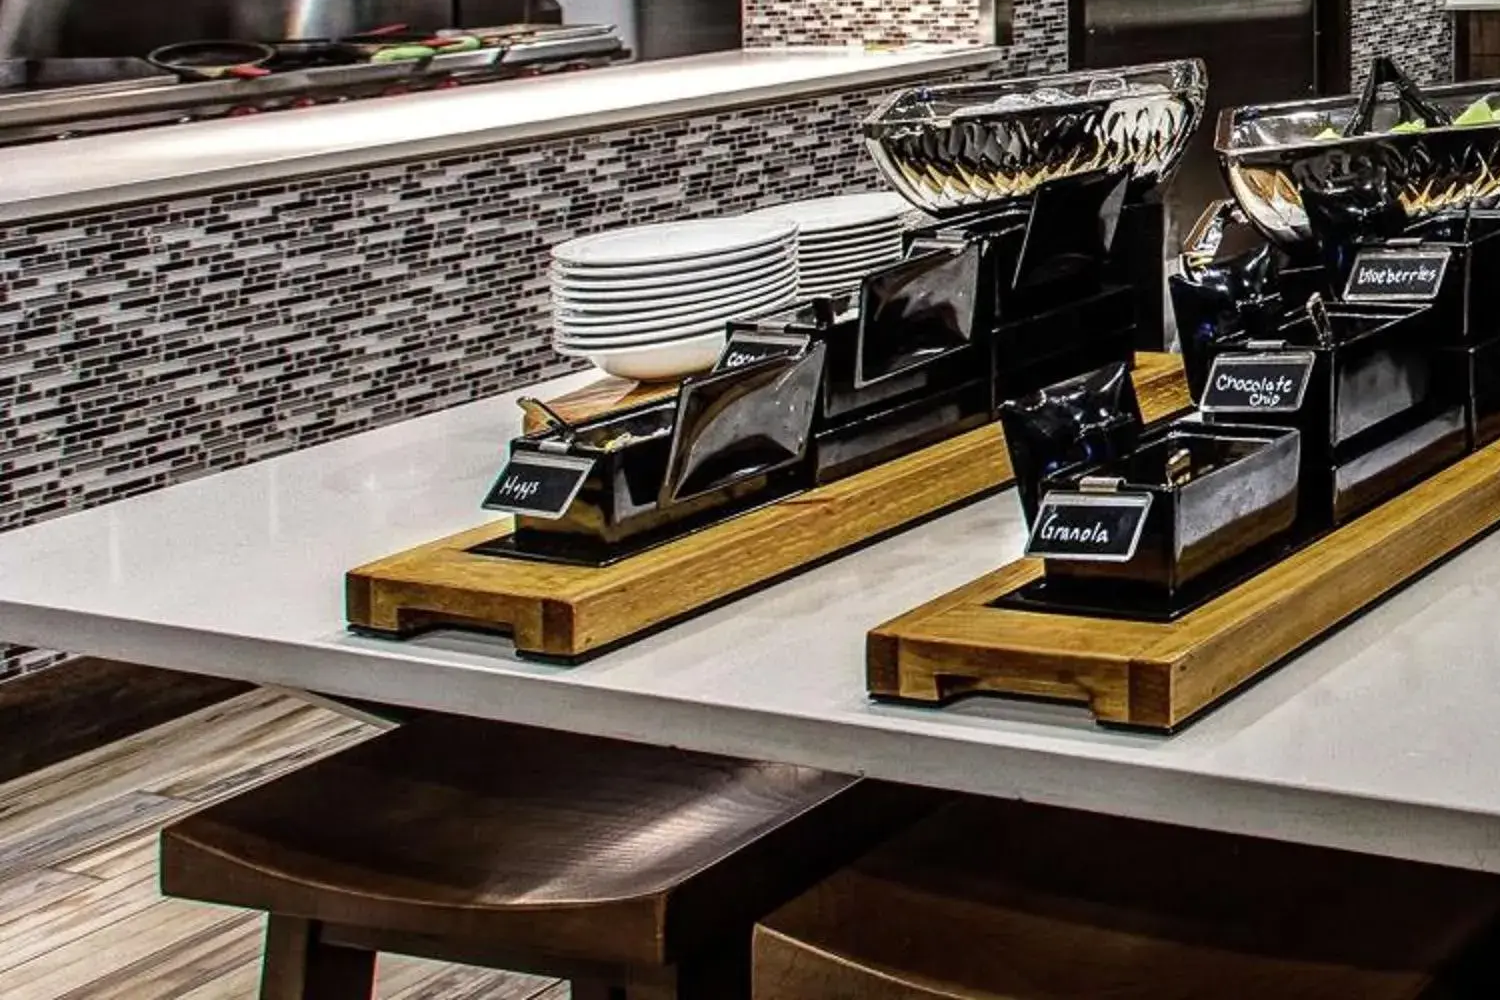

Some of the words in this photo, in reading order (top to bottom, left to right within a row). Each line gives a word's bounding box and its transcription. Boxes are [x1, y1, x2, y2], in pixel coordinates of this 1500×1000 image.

[1358, 266, 1437, 285] blueberries
[1215, 373, 1293, 393] Chocolate
[1249, 391, 1281, 407] Chip
[1040, 513, 1109, 543] Granola
